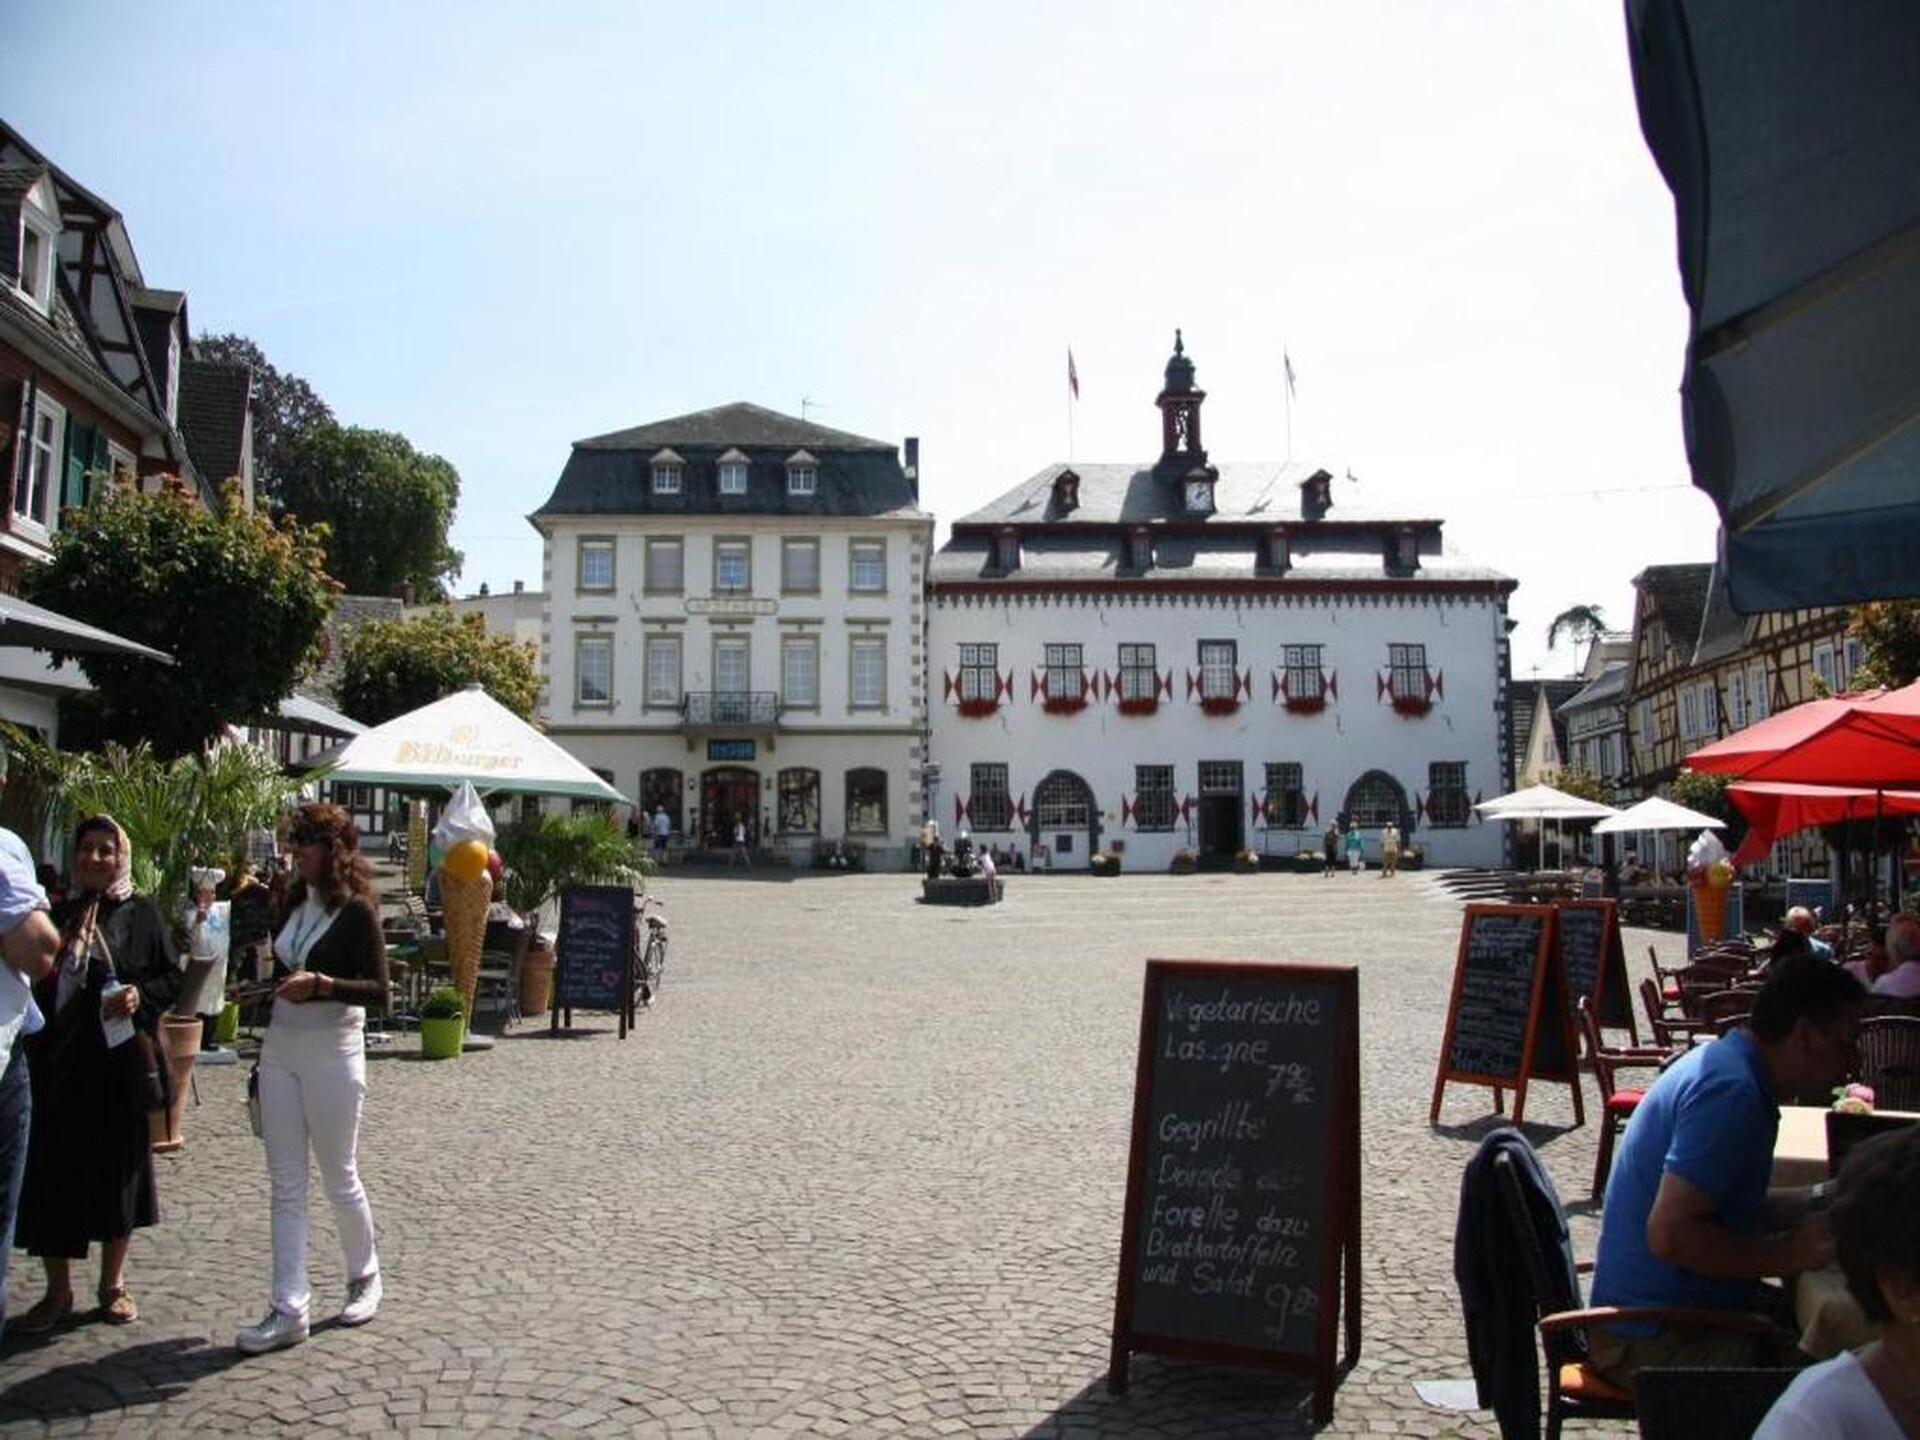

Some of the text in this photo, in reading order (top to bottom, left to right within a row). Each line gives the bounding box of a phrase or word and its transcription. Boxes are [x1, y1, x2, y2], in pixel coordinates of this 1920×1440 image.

[1163, 1031, 1269, 1073] Lasgne
[1151, 1193, 1240, 1231] Forelle
[1141, 1261, 1256, 1296] und Salat
